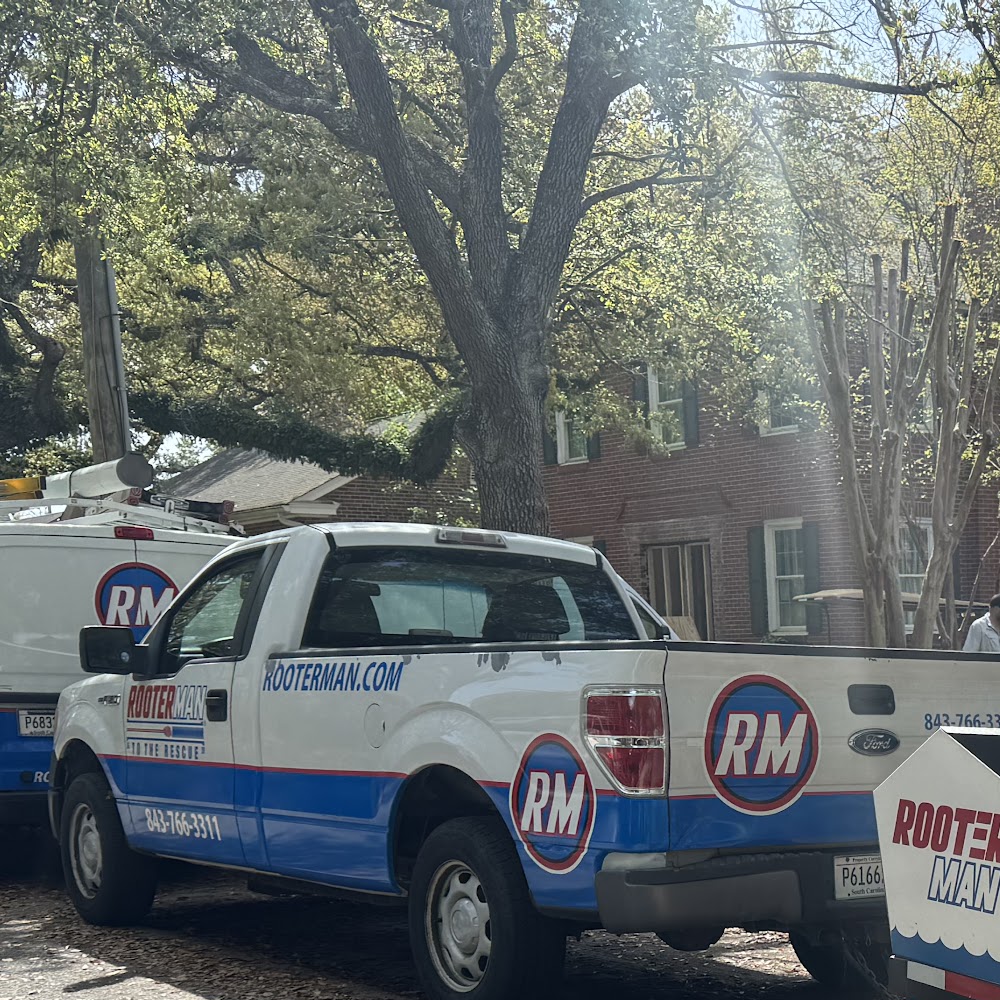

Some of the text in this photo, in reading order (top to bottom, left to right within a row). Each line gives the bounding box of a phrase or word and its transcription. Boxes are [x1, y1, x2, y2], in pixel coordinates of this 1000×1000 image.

[105, 585, 175, 626] RM
[262, 661, 404, 692] ROOTERMAN.COM
[127, 685, 207, 720] ROOTERMAN
[25, 716, 55, 729] P683
[144, 743, 159, 757] THE
[714, 713, 808, 776] RM
[863, 734, 891, 750] Ford
[520, 771, 586, 836] RM
[145, 807, 221, 841] 843-766-3311
[842, 865, 884, 887] P6166
[866, 887, 885, 895] Carolin
